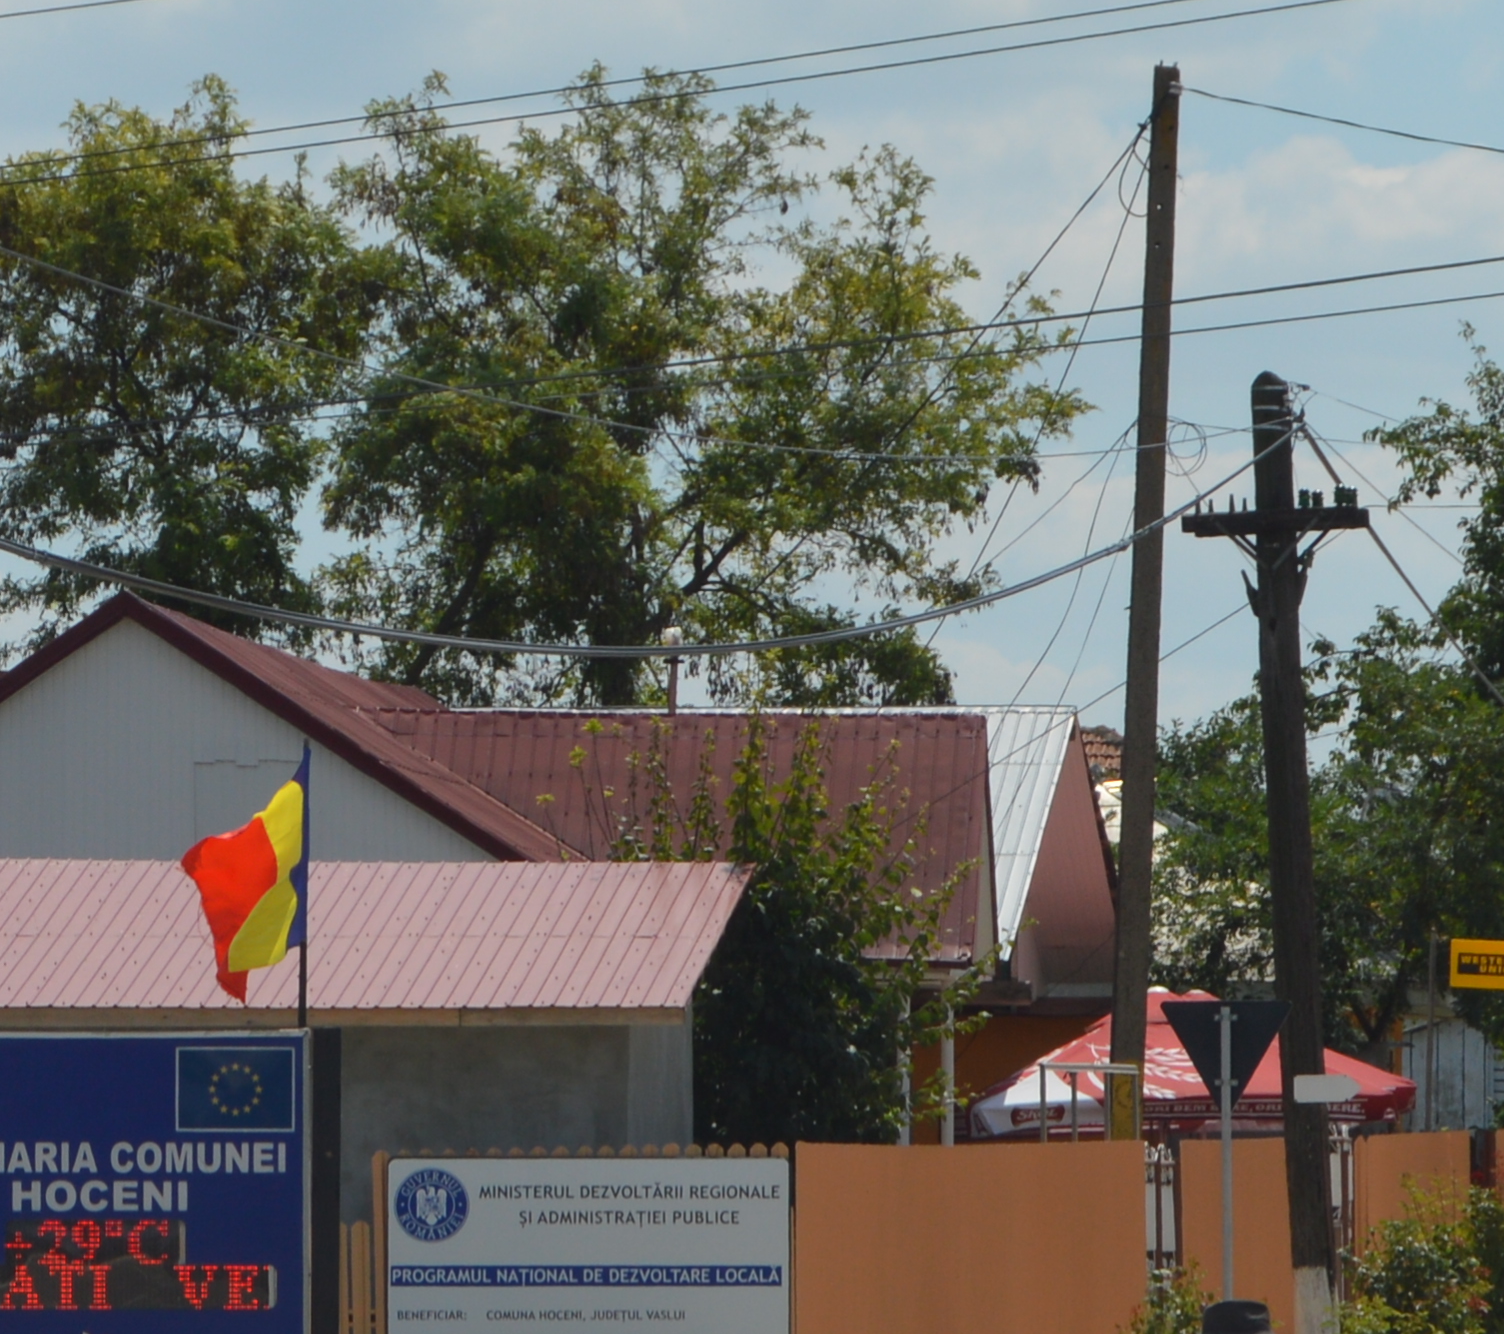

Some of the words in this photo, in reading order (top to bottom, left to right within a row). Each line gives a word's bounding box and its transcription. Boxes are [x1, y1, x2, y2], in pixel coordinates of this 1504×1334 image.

[110, 1141, 286, 1174] COMUNEI
[401, 1170, 464, 1198] GUVERNUL
[479, 1185, 574, 1199] MINISTERUL
[580, 1182, 683, 1199] DEZVOLTĂRII
[689, 1185, 780, 1199] REGIONALE
[11, 1180, 188, 1212] HOCENI
[673, 1210, 740, 1225] PUBLICE
[392, 1269, 491, 1283] PROGRAMUL
[583, 1269, 603, 1283] DE
[609, 1269, 710, 1283] DEZVOLTARE
[716, 1266, 780, 1283] LOCALĂ
[173, 1265, 271, 1310] VE
[397, 1310, 467, 1321] BENEFICIAR:
[486, 1310, 536, 1321] COMUNA
[539, 1310, 586, 1322] HOCENI,
[646, 1310, 685, 1321] VASLUI
